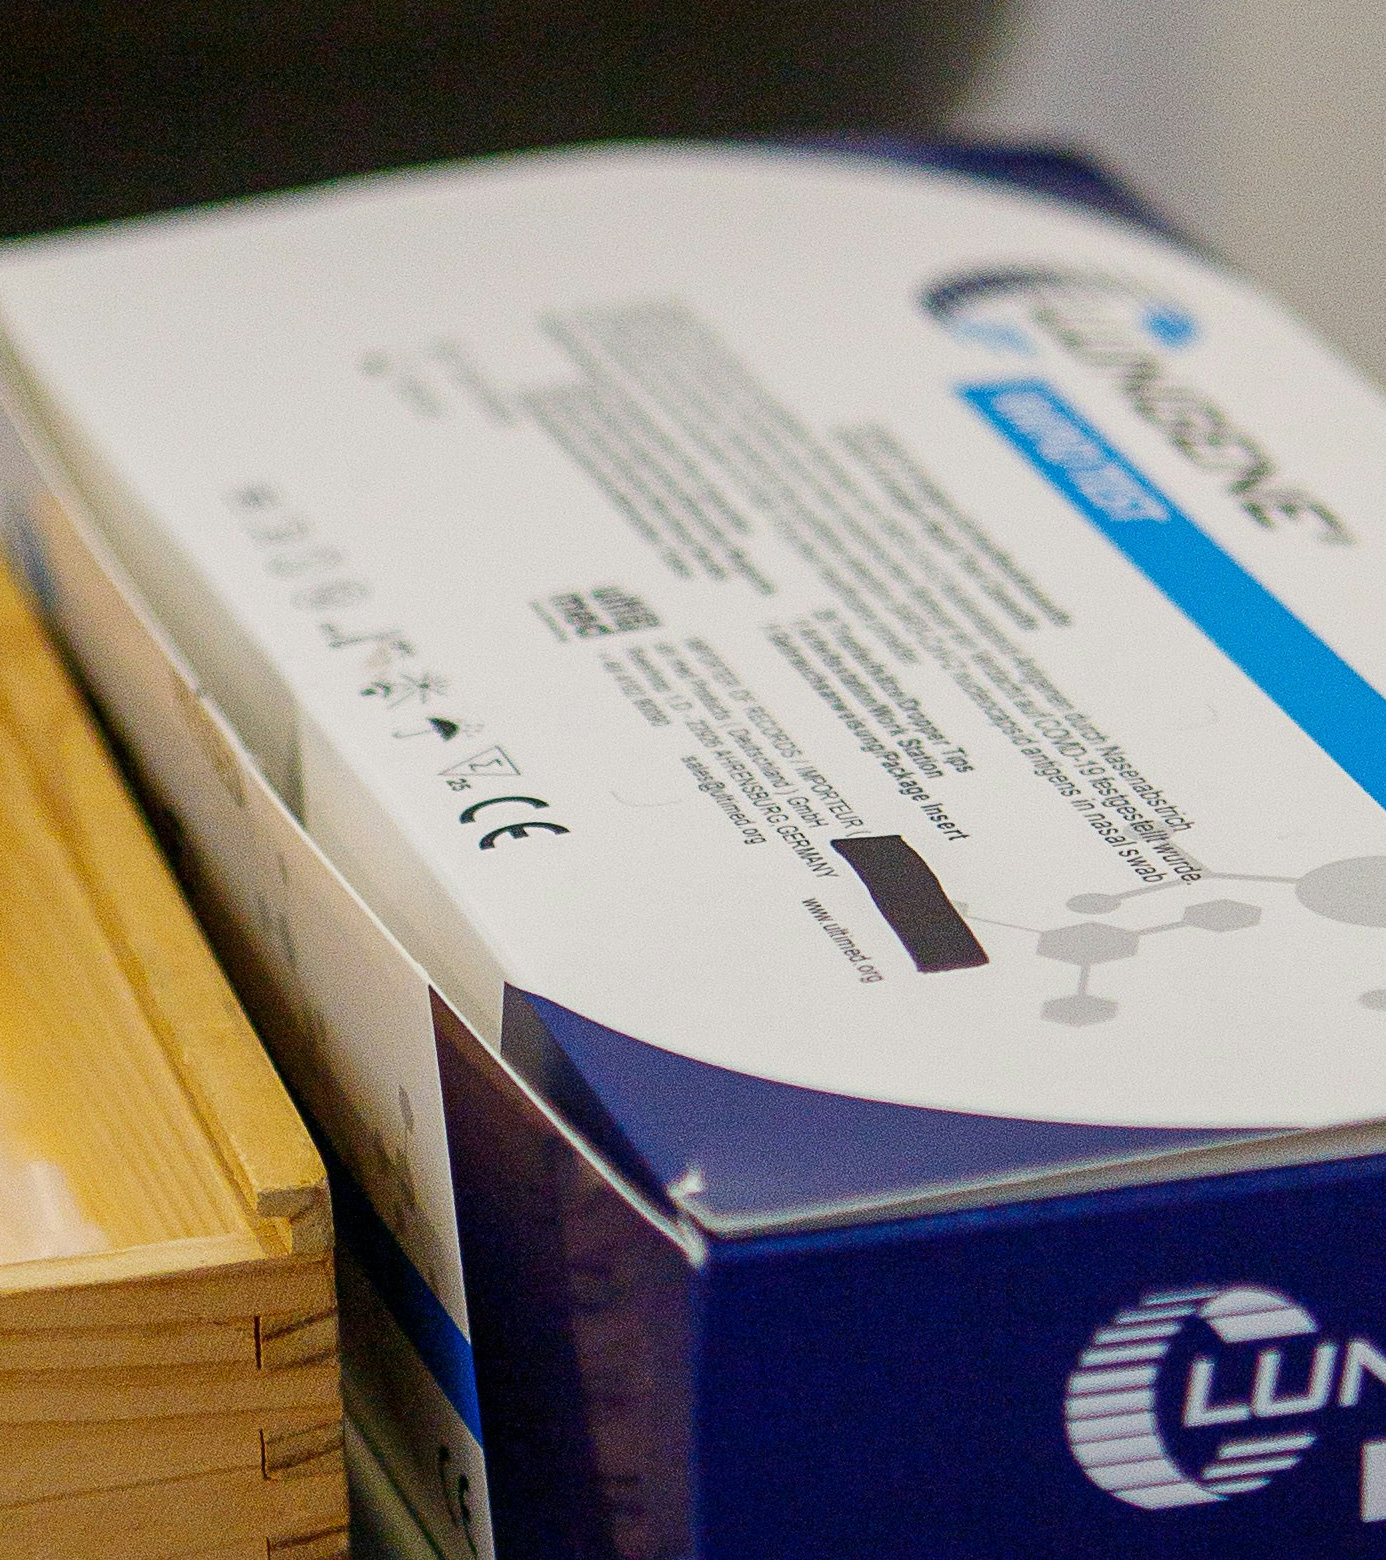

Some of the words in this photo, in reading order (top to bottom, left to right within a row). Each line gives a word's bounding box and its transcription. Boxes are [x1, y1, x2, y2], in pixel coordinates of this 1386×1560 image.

[729, 729, 792, 788] Deutschland
[787, 797, 827, 827] GmbH
[898, 738, 944, 778] Station
[944, 747, 974, 773] Tips
[1034, 720, 1106, 776] COVID-19
[798, 767, 864, 827] IMPORTEUR
[1021, 747, 1081, 797] antigens
[1071, 798, 1095, 811] in
[1086, 813, 1135, 847] nasal
[1118, 849, 1165, 882] swab
[1100, 746, 1193, 832] Nasenabstrich
[922, 803, 968, 841] Insert
[683, 756, 766, 845] sales@ultimed.org
[803, 898, 882, 983] www.ultimed.org
